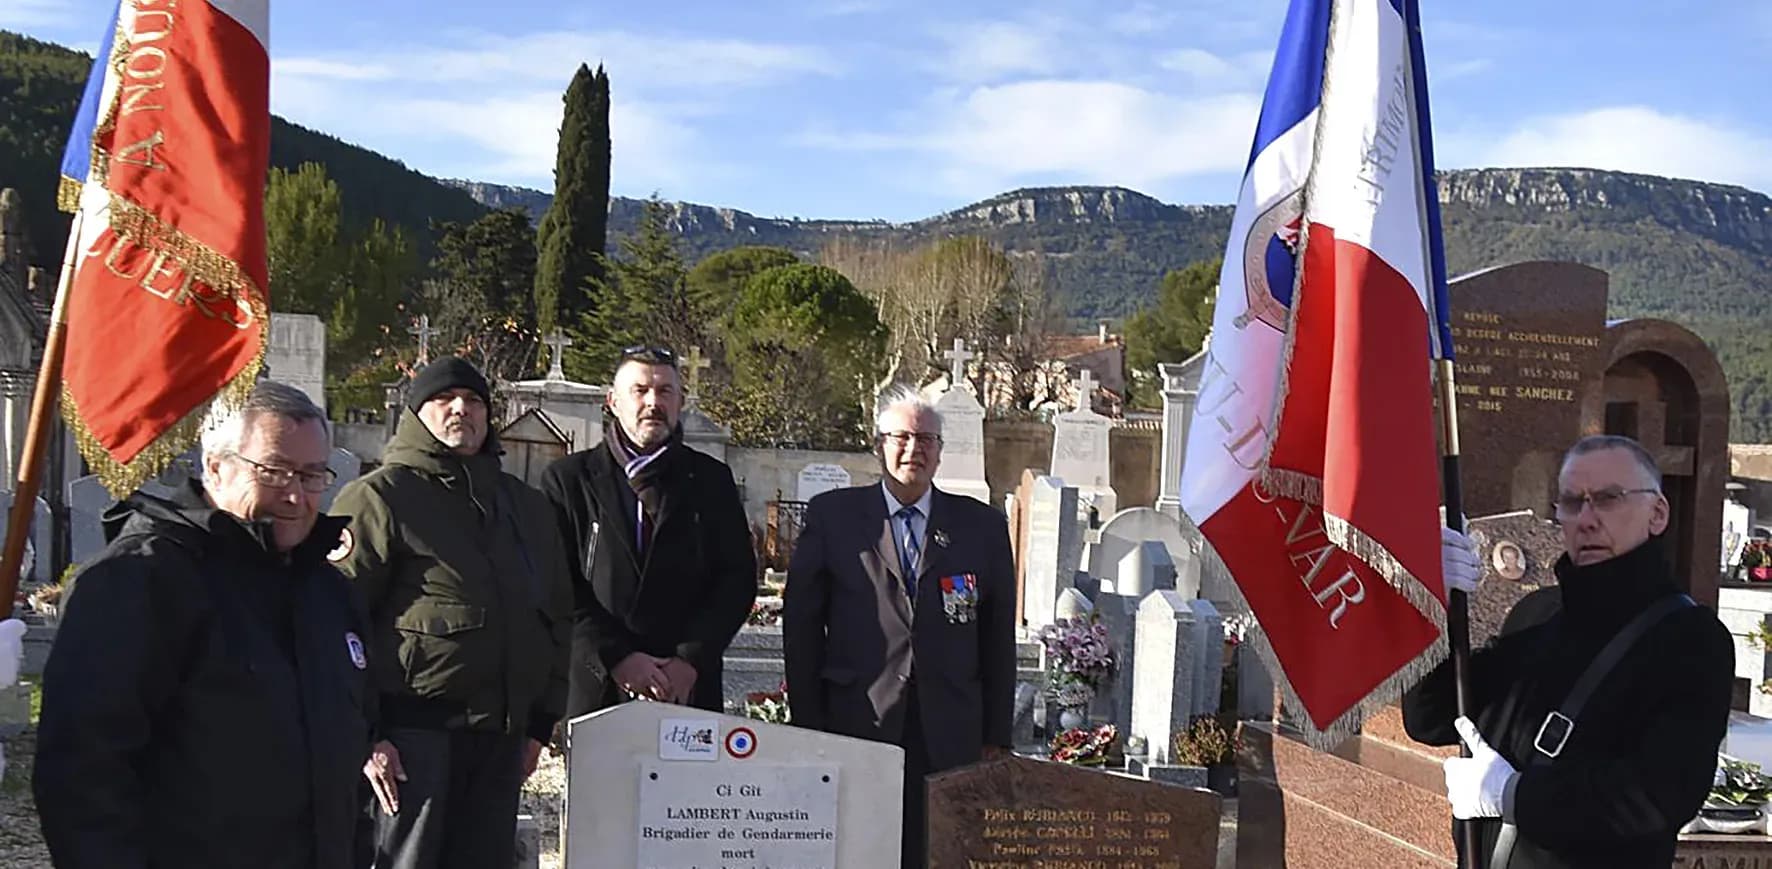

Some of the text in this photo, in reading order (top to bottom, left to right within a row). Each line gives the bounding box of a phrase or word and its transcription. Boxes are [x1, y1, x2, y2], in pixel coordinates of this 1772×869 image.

[122, 0, 176, 116] NOU
[1516, 386, 1575, 401] SANCHEZ
[716, 784, 731, 797] Ci
[667, 807, 809, 822] LAMBERT Augustin
[643, 826, 833, 841] Brigadier de Gendarmerie
[721, 849, 755, 860] mort
